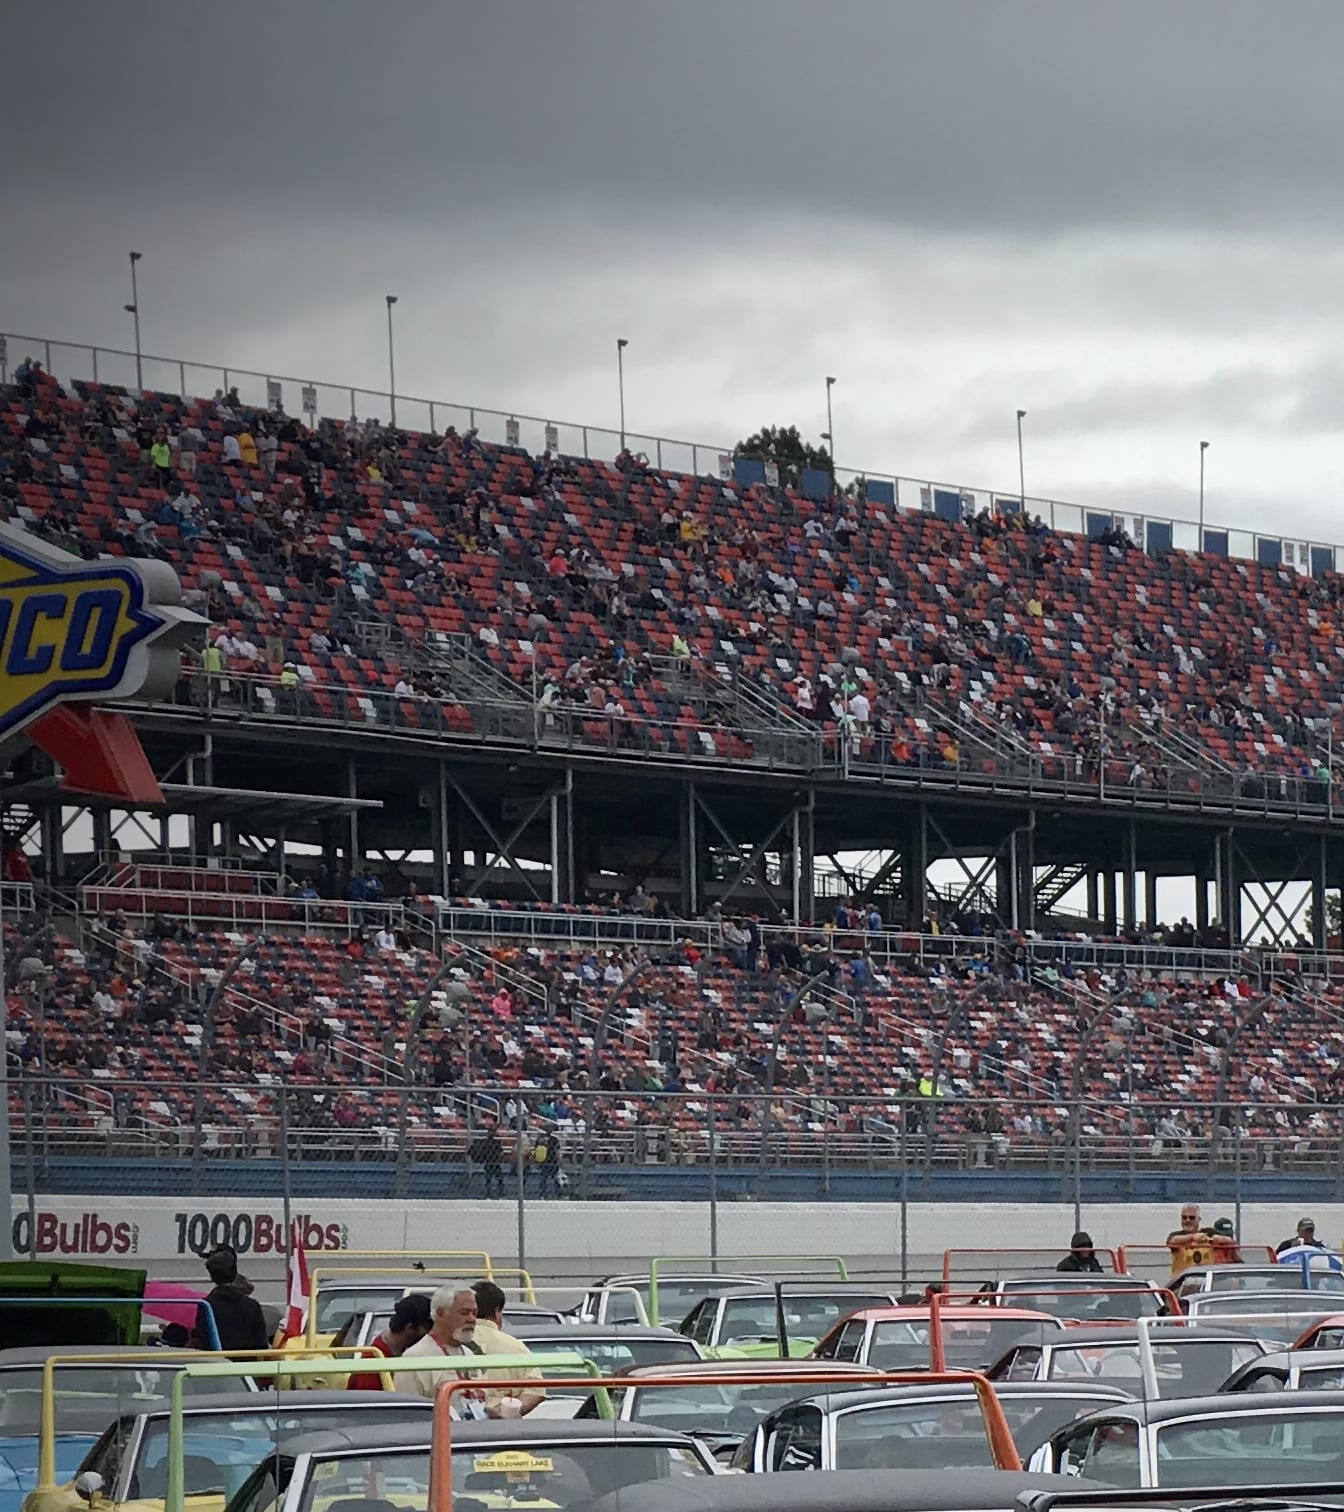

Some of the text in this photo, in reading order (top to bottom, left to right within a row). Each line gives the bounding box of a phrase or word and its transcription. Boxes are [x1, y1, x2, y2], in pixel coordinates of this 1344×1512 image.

[0, 588, 122, 676] CO
[174, 1212, 341, 1255] 1000Bulbs
[531, 1459, 549, 1467] LAKE
